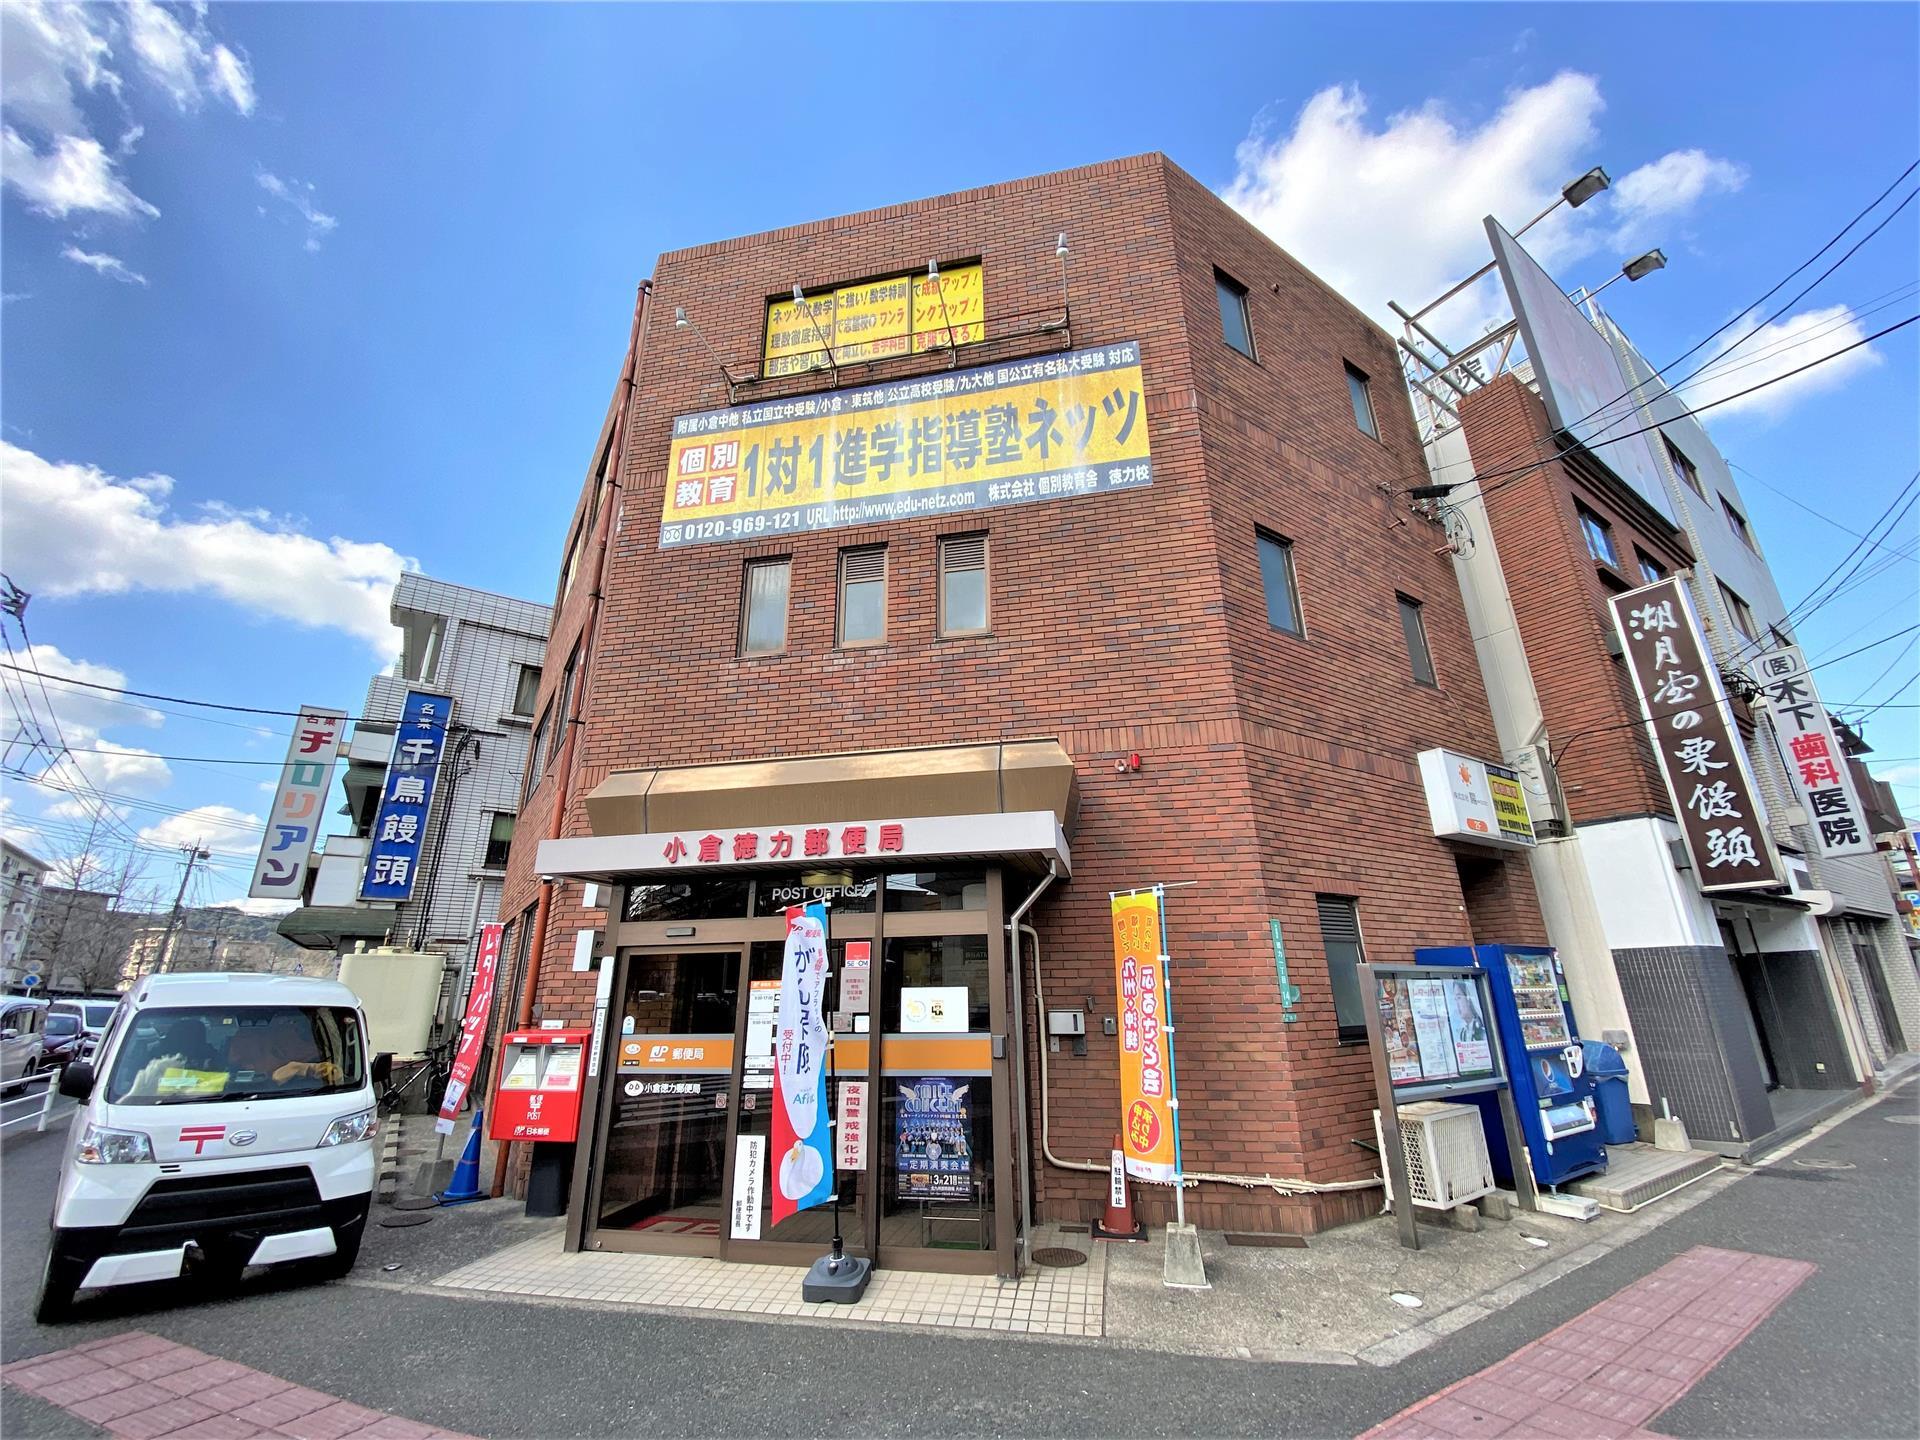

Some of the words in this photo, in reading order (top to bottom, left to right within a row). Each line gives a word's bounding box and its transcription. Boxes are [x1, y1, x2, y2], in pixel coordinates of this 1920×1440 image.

[1108, 347, 1135, 366] 対応
[684, 510, 800, 541] 0120-969-121
[806, 507, 830, 526] URL
[988, 477, 1035, 503] 株式会社
[1108, 463, 1150, 486] 徳力校
[260, 729, 334, 887] チロリアン
[371, 738, 436, 887] 千鳥饅頭
[662, 823, 904, 864] 小倉徳力郵便局
[771, 886, 809, 900] POST
[812, 884, 866, 899] OFFICE
[460, 933, 494, 1054] レターパック
[671, 1047, 705, 1061] 郵便局
[781, 1029, 794, 1075] 受付中!
[643, 1082, 701, 1095] 小倉徳力郵便局
[526, 1111, 542, 1120] POST
[844, 1085, 861, 1166] 夜間警戒強化中
[745, 1140, 758, 1232] 防犯カメラ作動中です
[909, 1160, 959, 1170] 定期演奏会
